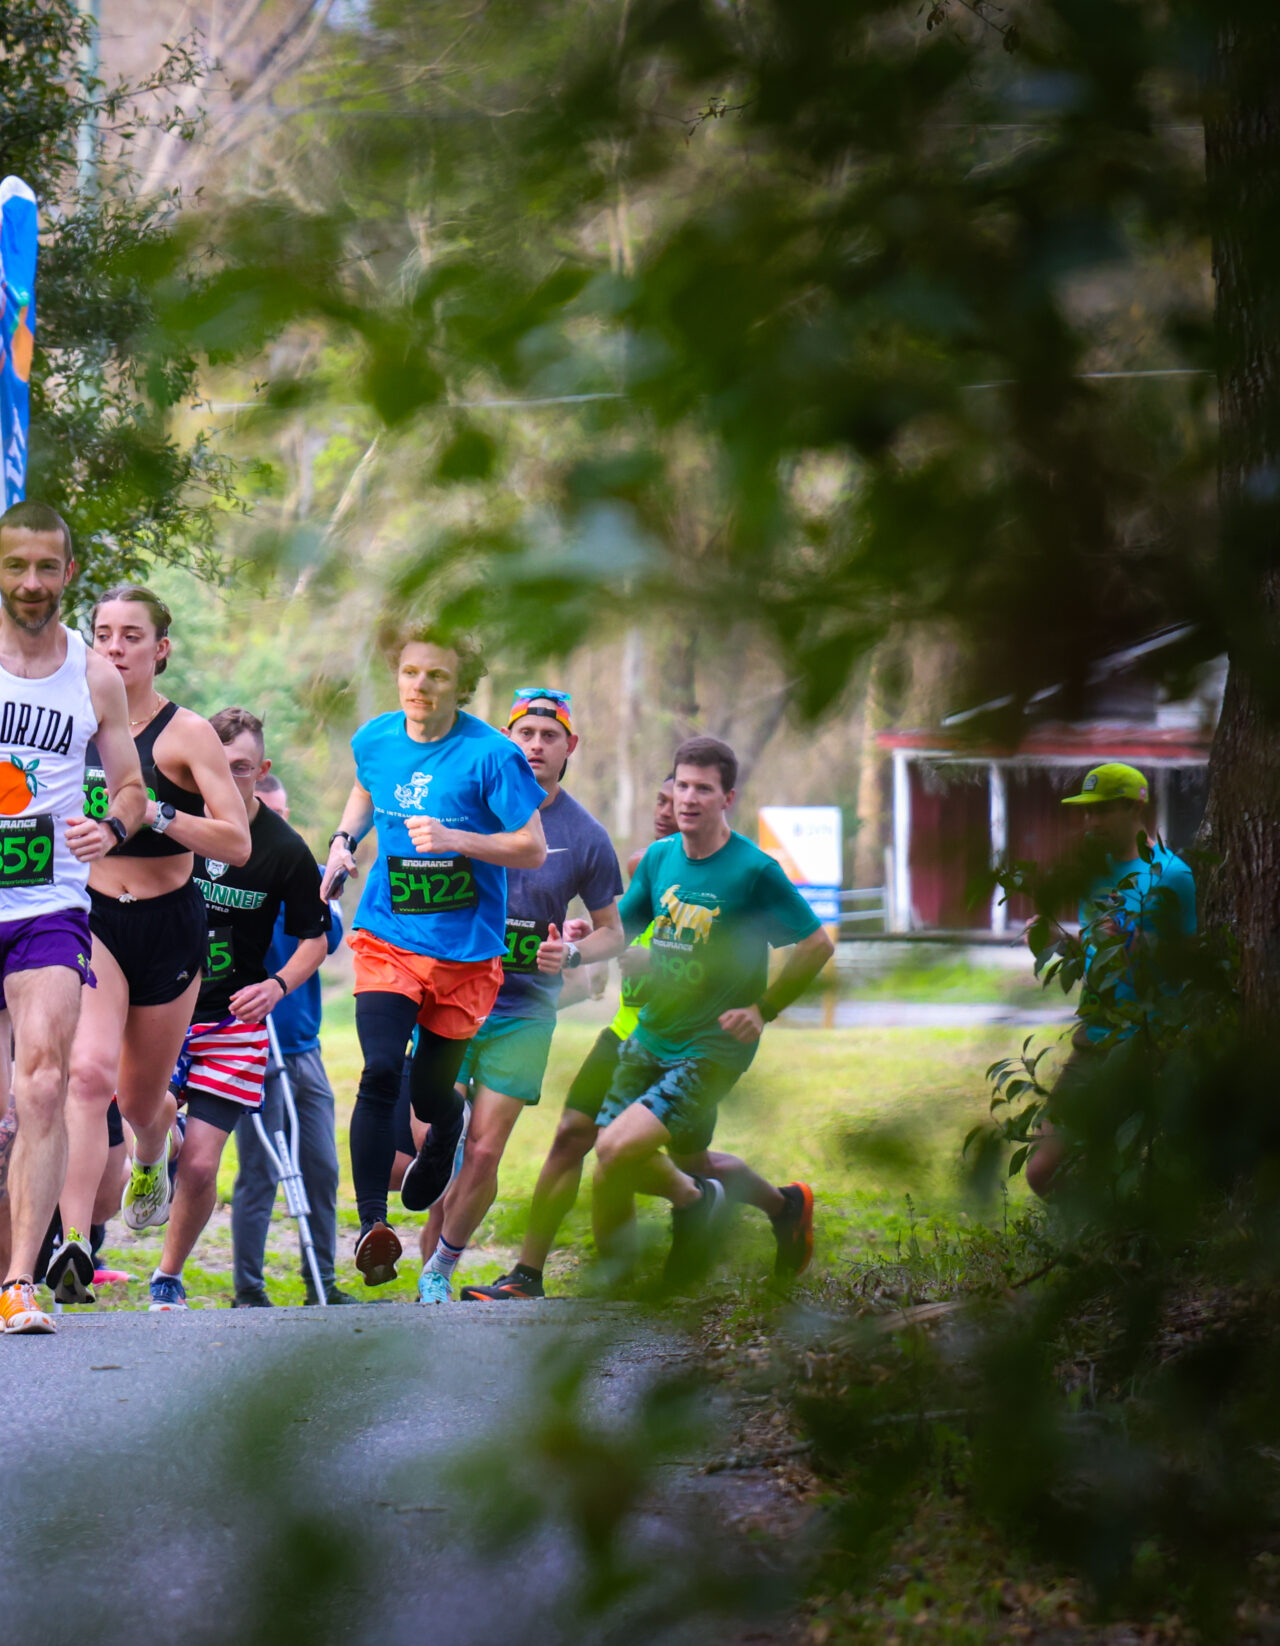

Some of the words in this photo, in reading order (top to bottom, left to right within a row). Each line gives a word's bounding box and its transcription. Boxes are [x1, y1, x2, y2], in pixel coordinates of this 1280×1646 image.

[401, 859, 454, 868] ENDURANCE
[389, 871, 475, 904] 5422
[501, 931, 542, 965] 19
